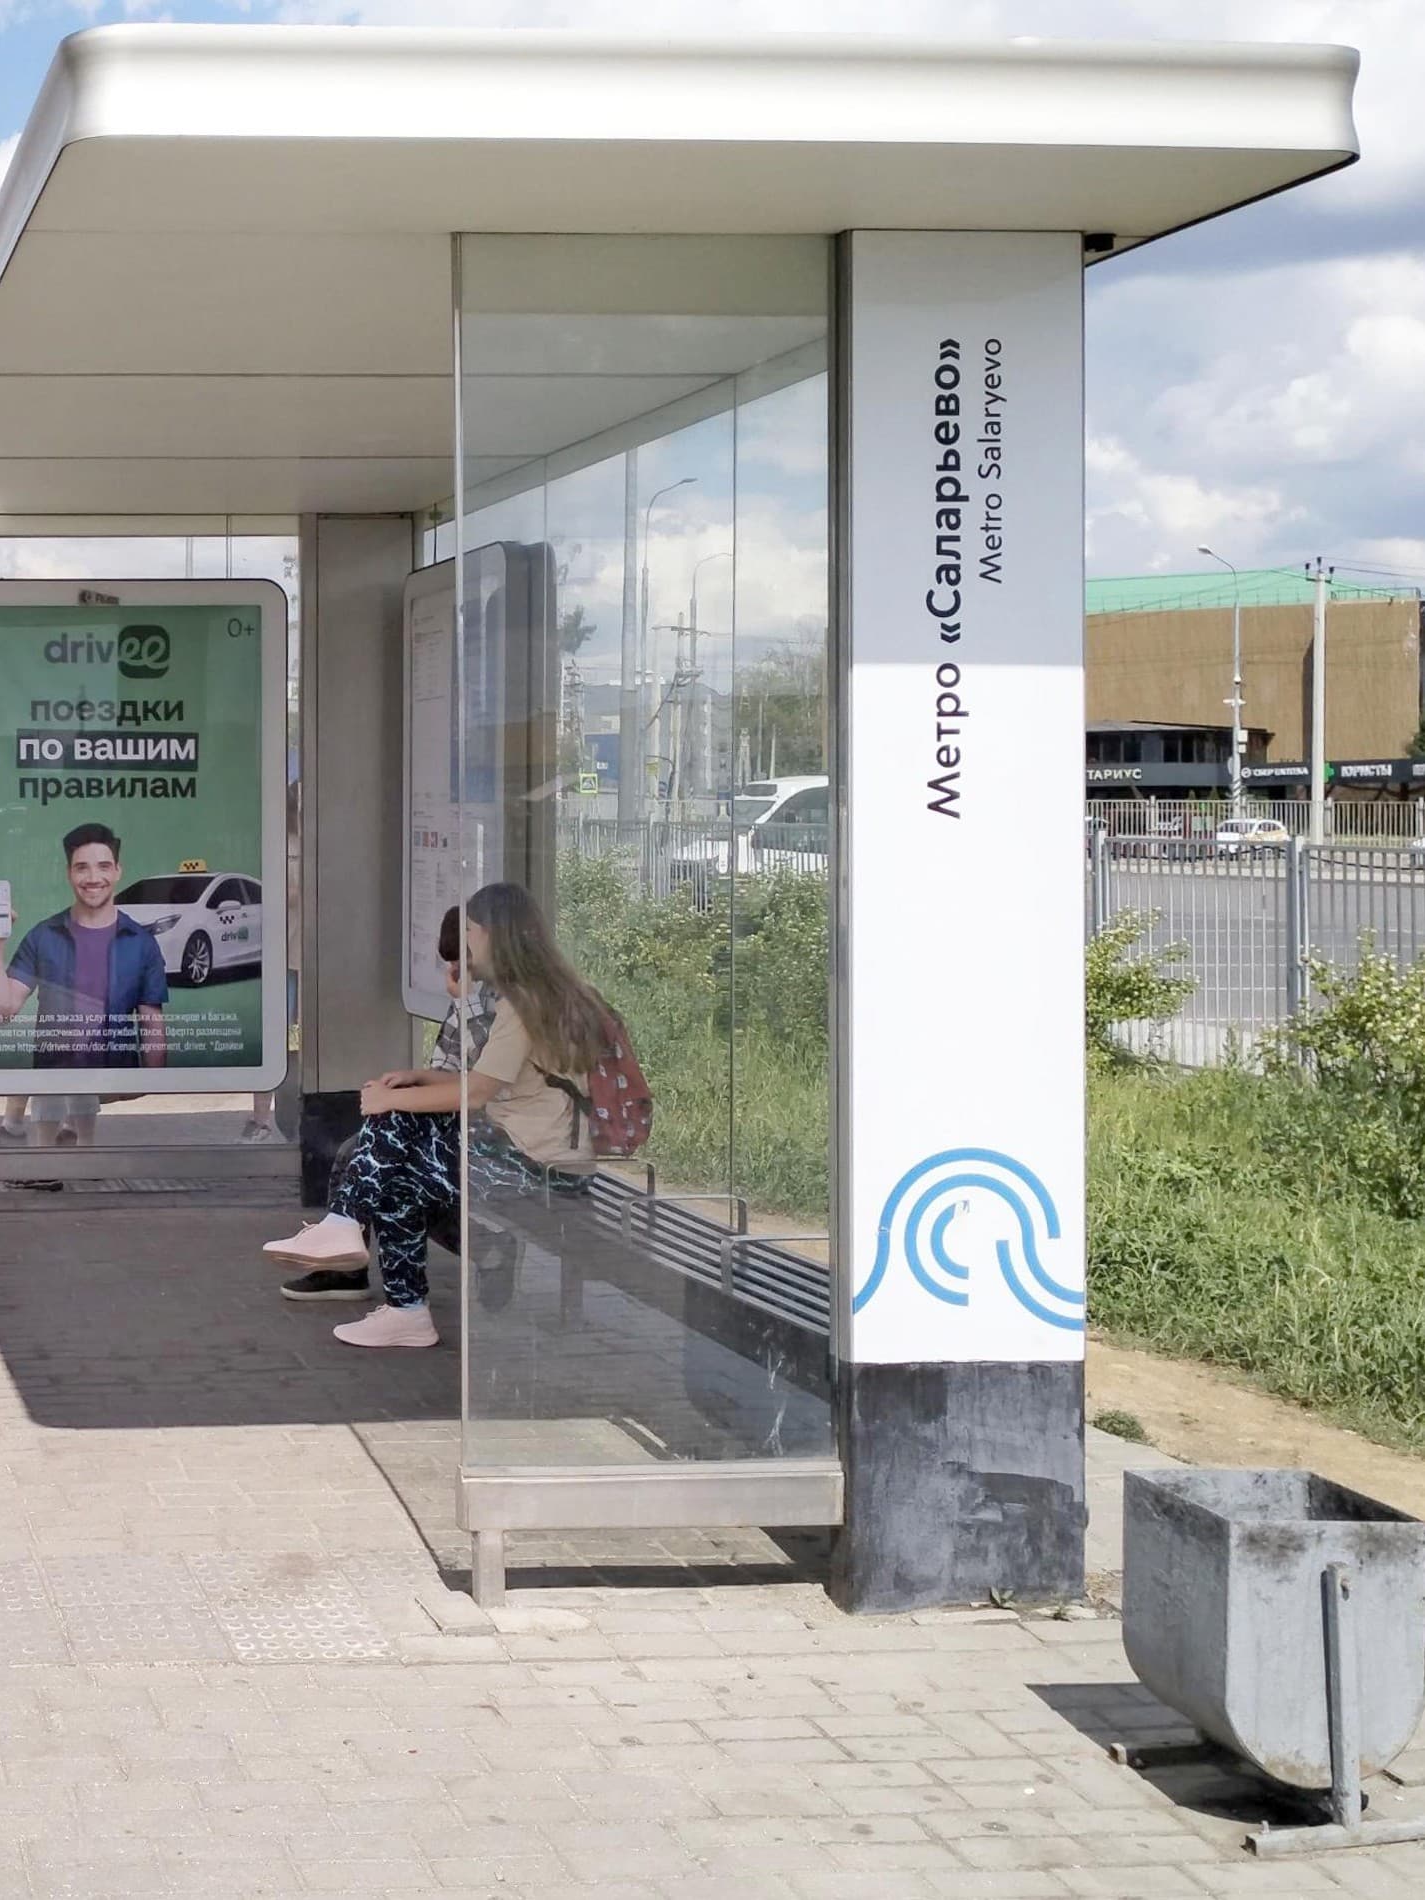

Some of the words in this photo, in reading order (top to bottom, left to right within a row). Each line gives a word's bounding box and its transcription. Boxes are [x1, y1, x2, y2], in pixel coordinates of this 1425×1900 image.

[977, 337, 1008, 480] Salaryevo
[926, 337, 970, 645] «Саларьево»
[978, 493, 1003, 585] Metro
[227, 618, 256, 638] 0+
[44, 632, 170, 671] drivee
[30, 699, 185, 727] поездки
[19, 738, 63, 761] по
[75, 738, 196, 761] вашим
[927, 662, 969, 819] Метро
[19, 776, 198, 806] правилам
[1086, 768, 1142, 780] ТАРИУС
